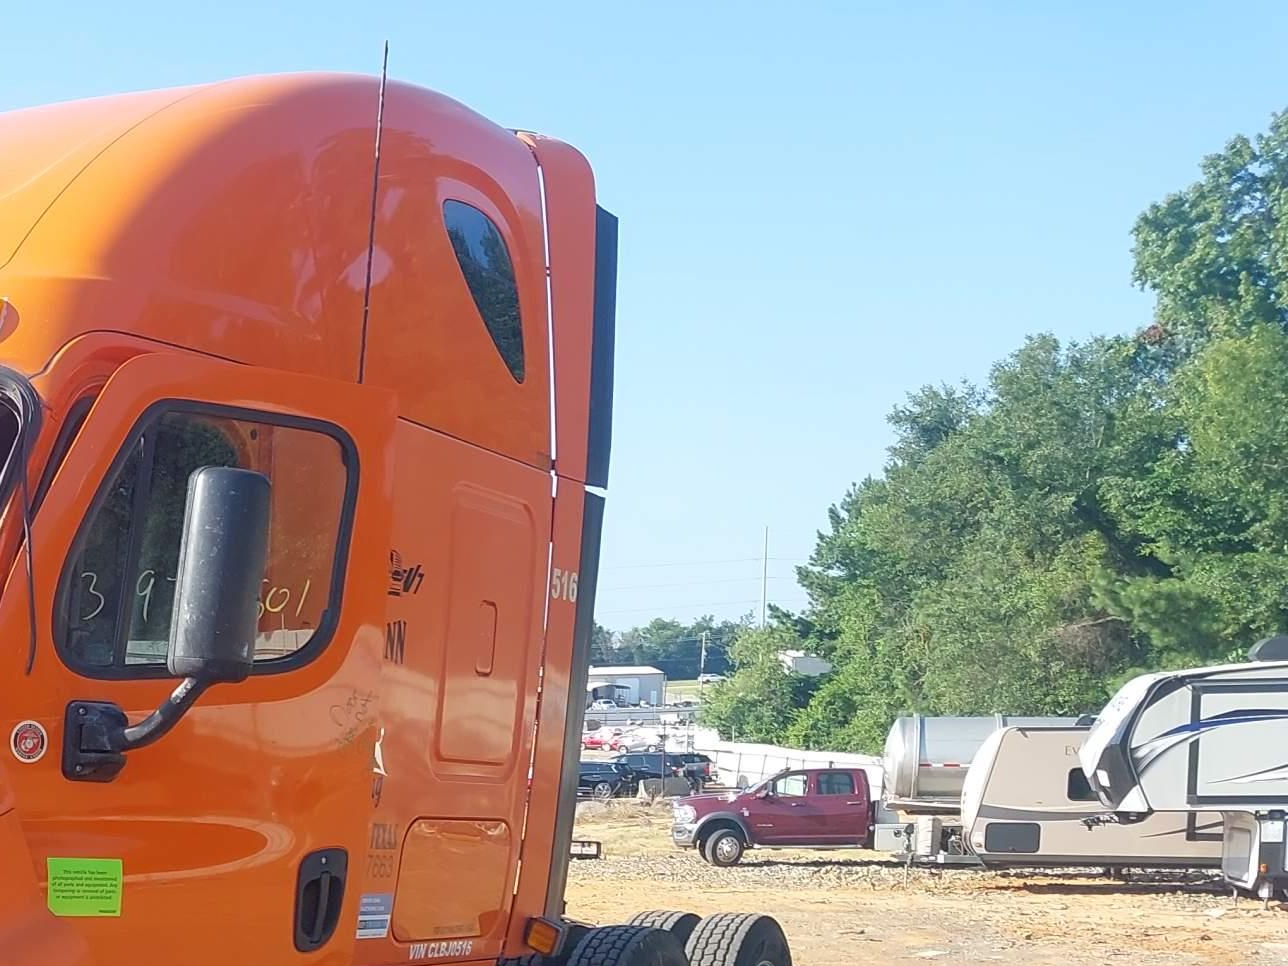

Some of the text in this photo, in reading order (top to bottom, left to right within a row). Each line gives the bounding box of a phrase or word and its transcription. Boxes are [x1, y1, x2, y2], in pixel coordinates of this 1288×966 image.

[552, 568, 578, 602] 516
[409, 940, 472, 960] VIN CLBJ0516
